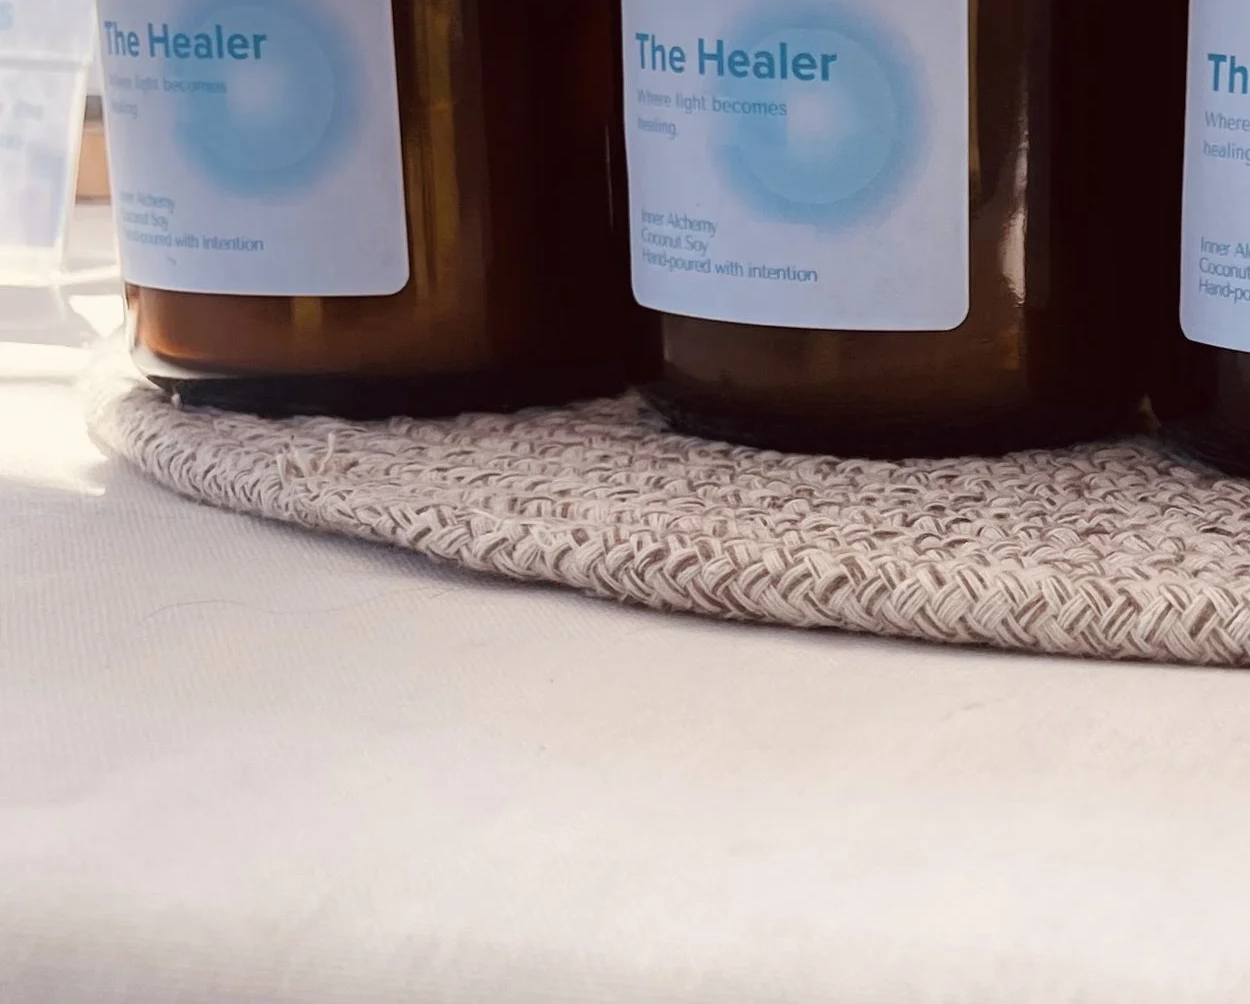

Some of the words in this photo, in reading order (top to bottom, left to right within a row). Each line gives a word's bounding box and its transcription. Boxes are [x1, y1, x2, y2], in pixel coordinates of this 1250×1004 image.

[104, 20, 140, 58] The
[147, 22, 268, 60] Healer
[635, 32, 686, 74] The
[698, 38, 838, 81] Healer
[637, 88, 672, 107] Where
[676, 91, 706, 114] light
[712, 95, 788, 116] becomes
[1204, 110, 1250, 133] Where
[667, 213, 718, 238] Alchemy
[174, 233, 199, 250] with
[203, 235, 265, 252] intention
[641, 227, 682, 247] Coconut
[685, 234, 709, 257] Soy
[1200, 236, 1231, 256] Inner
[642, 248, 711, 273] Hand-poured
[714, 260, 744, 278] with
[748, 263, 818, 283] intention
